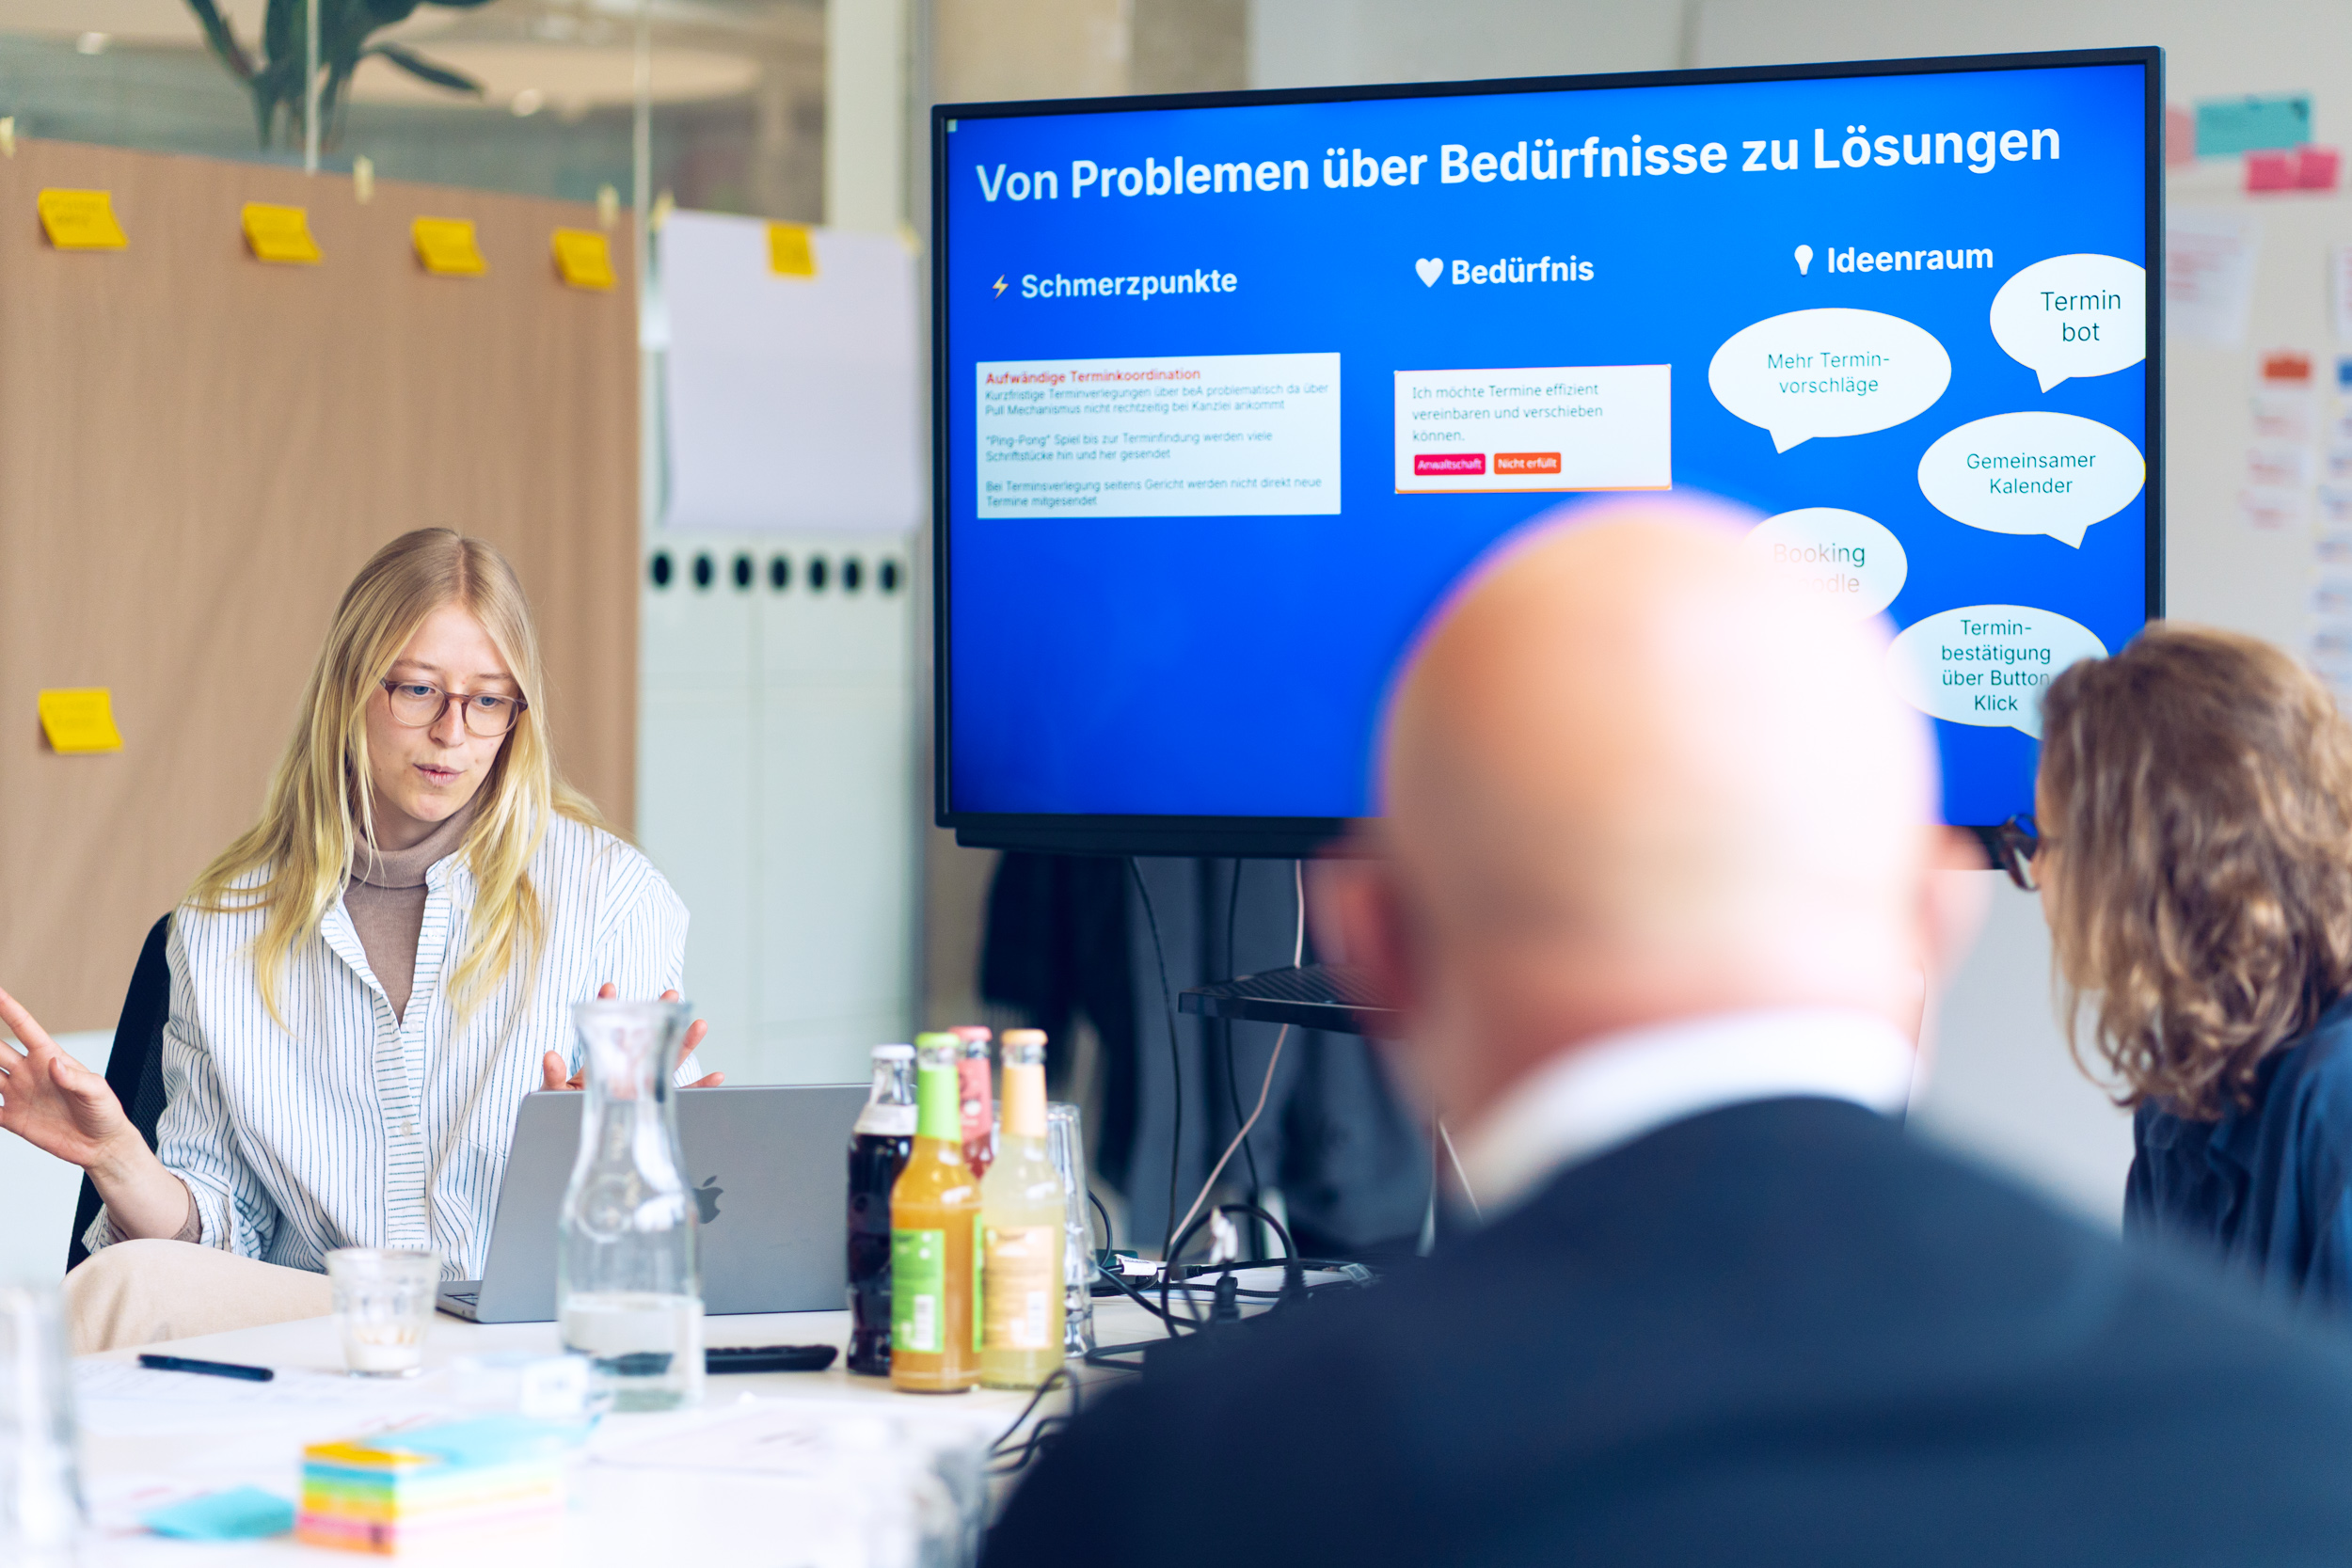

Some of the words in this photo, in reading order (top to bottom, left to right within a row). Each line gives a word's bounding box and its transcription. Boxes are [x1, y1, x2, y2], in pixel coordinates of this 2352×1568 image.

[975, 163, 1058, 202] Von
[1072, 155, 1310, 199] Problemen
[1323, 147, 1427, 189] über
[1440, 134, 1728, 185] Bedürfnisse
[1741, 139, 1799, 172] zu
[1814, 124, 2060, 175] Lösungen
[1828, 246, 1994, 274] Ideenraum
[1452, 255, 1596, 285] Bedürfnis
[1021, 268, 1238, 301] Schmerzpunkte
[2041, 289, 2122, 312] Termin
[2061, 322, 2101, 343] bot
[1767, 353, 1814, 370] Mehr
[1820, 351, 1891, 369] Termin-
[986, 372, 1066, 386] Aufwändige
[1071, 369, 1200, 383] Terminkoordination
[1779, 376, 1880, 396] vorschläge
[985, 388, 1045, 403] Kurzfristige
[1049, 387, 1152, 402] Terminverlegungen
[1154, 386, 1179, 397] über
[1206, 384, 1283, 398] problematisch
[1286, 383, 1300, 394] da
[1303, 382, 1328, 394] über
[1412, 386, 1433, 400] Ich
[1436, 385, 1486, 399] möchte
[1488, 383, 1542, 397] Termine
[1546, 382, 1599, 396] effizient
[985, 405, 1005, 416] Pull
[1008, 404, 1081, 416] Mechanismus
[1084, 403, 1111, 414] nicht
[1113, 402, 1169, 415] rechtzeitig
[1172, 402, 1189, 412] bei
[1192, 400, 1232, 412] Kanzlei
[1234, 399, 1285, 411] ankommt
[1411, 406, 1491, 420] vereinbaren
[1494, 405, 1520, 420] und
[1523, 404, 1604, 419] verschieben
[1054, 434, 1081, 447] Spiel
[1083, 434, 1099, 444] bis
[1102, 434, 1119, 444] zur
[1122, 432, 1200, 446] Terminfindung
[1203, 431, 1245, 442] werden
[1247, 431, 1273, 442] viele
[1412, 429, 1466, 442] können.
[985, 451, 1054, 463] Schriftstücke
[1057, 450, 1073, 461] hin
[1076, 450, 1097, 461] und
[1099, 450, 1117, 460] her
[1120, 449, 1171, 462] gesendet
[1418, 457, 1483, 471] Anwaltschaft
[1498, 456, 1524, 469] Nicht
[1526, 455, 1558, 469] erfüllt
[1965, 452, 2097, 470] Gemeinsamer
[985, 481, 1003, 493] Bei
[1006, 480, 1102, 494] Terminsverlegung
[1104, 479, 1141, 490] seitens
[1144, 478, 1184, 490] Gericht
[1187, 477, 1228, 489] werden
[1231, 477, 1258, 488] nicht
[1261, 477, 1292, 488] direkt
[1294, 477, 1323, 488] neue
[1989, 477, 2074, 495] Kalender
[986, 496, 1029, 508] Termine
[1031, 495, 1097, 509] mitgesendet
[1773, 543, 1866, 568] Booking
[1961, 619, 2032, 636] Termin-
[1942, 644, 2051, 665] bestätigung
[1943, 670, 1984, 686] über
[1991, 670, 2050, 686] Button
[1975, 694, 2018, 711] Klick
